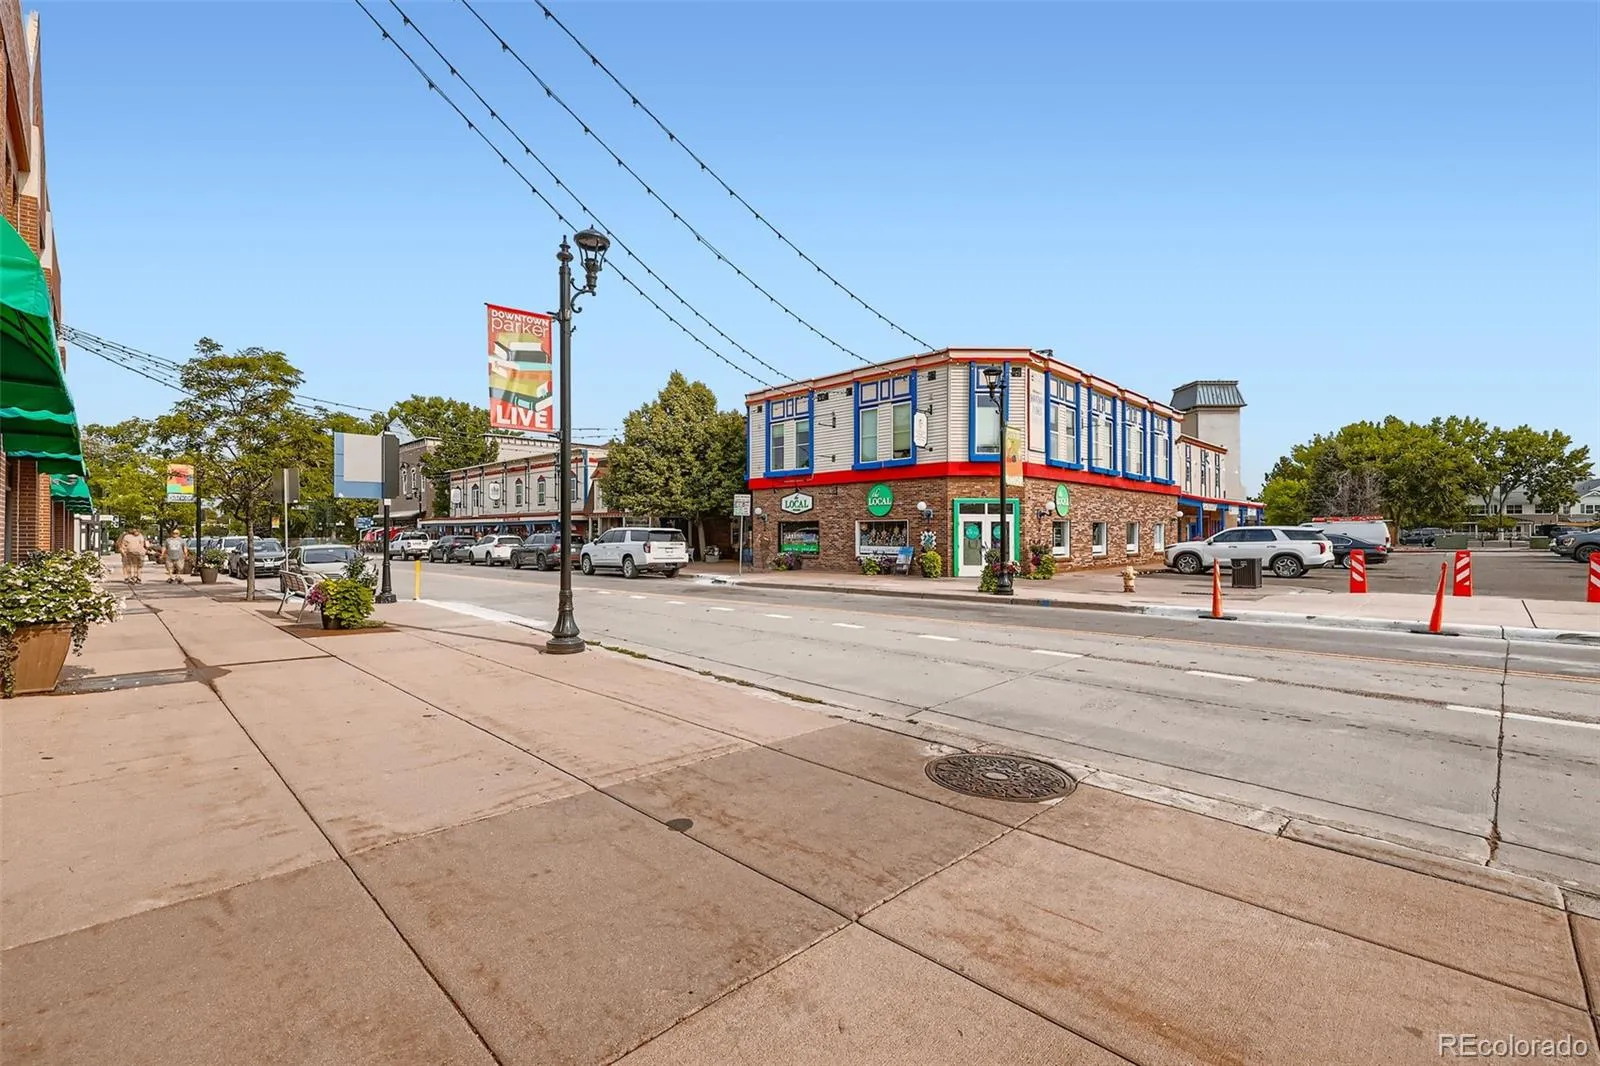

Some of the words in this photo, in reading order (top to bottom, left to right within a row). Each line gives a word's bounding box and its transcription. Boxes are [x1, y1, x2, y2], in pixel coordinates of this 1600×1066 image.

[491, 309, 550, 327] DOWNTOWN
[491, 317, 549, 338] parker
[496, 405, 548, 429] LIVE
[785, 500, 809, 509] LOCAL
[868, 497, 892, 506] LOCAL
